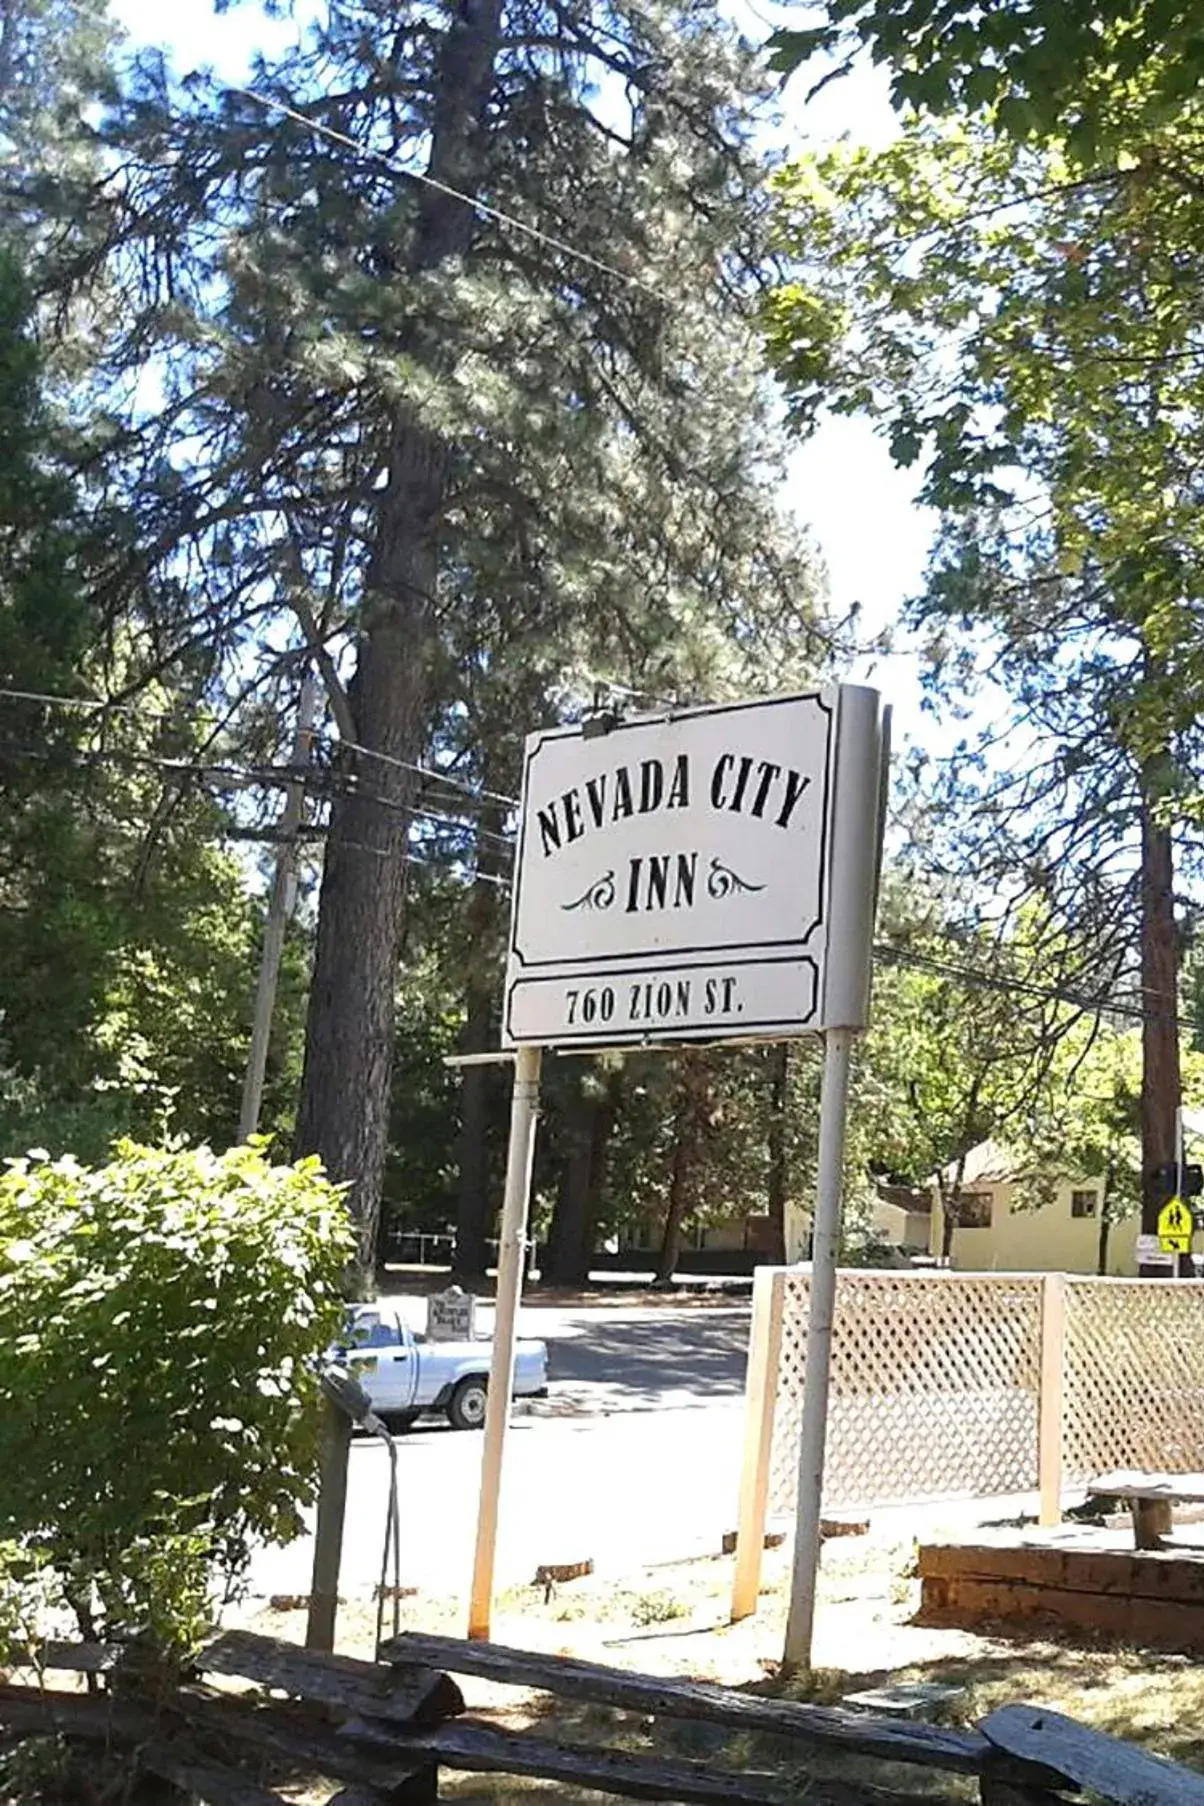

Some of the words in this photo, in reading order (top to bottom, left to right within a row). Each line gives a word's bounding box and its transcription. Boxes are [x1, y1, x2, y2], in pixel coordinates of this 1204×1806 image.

[536, 754, 690, 858] NEVADA
[710, 753, 812, 830] CITY
[625, 852, 700, 913] INN
[565, 986, 615, 1025] 760
[629, 980, 691, 1021] ZION
[704, 977, 745, 1015] ST.
